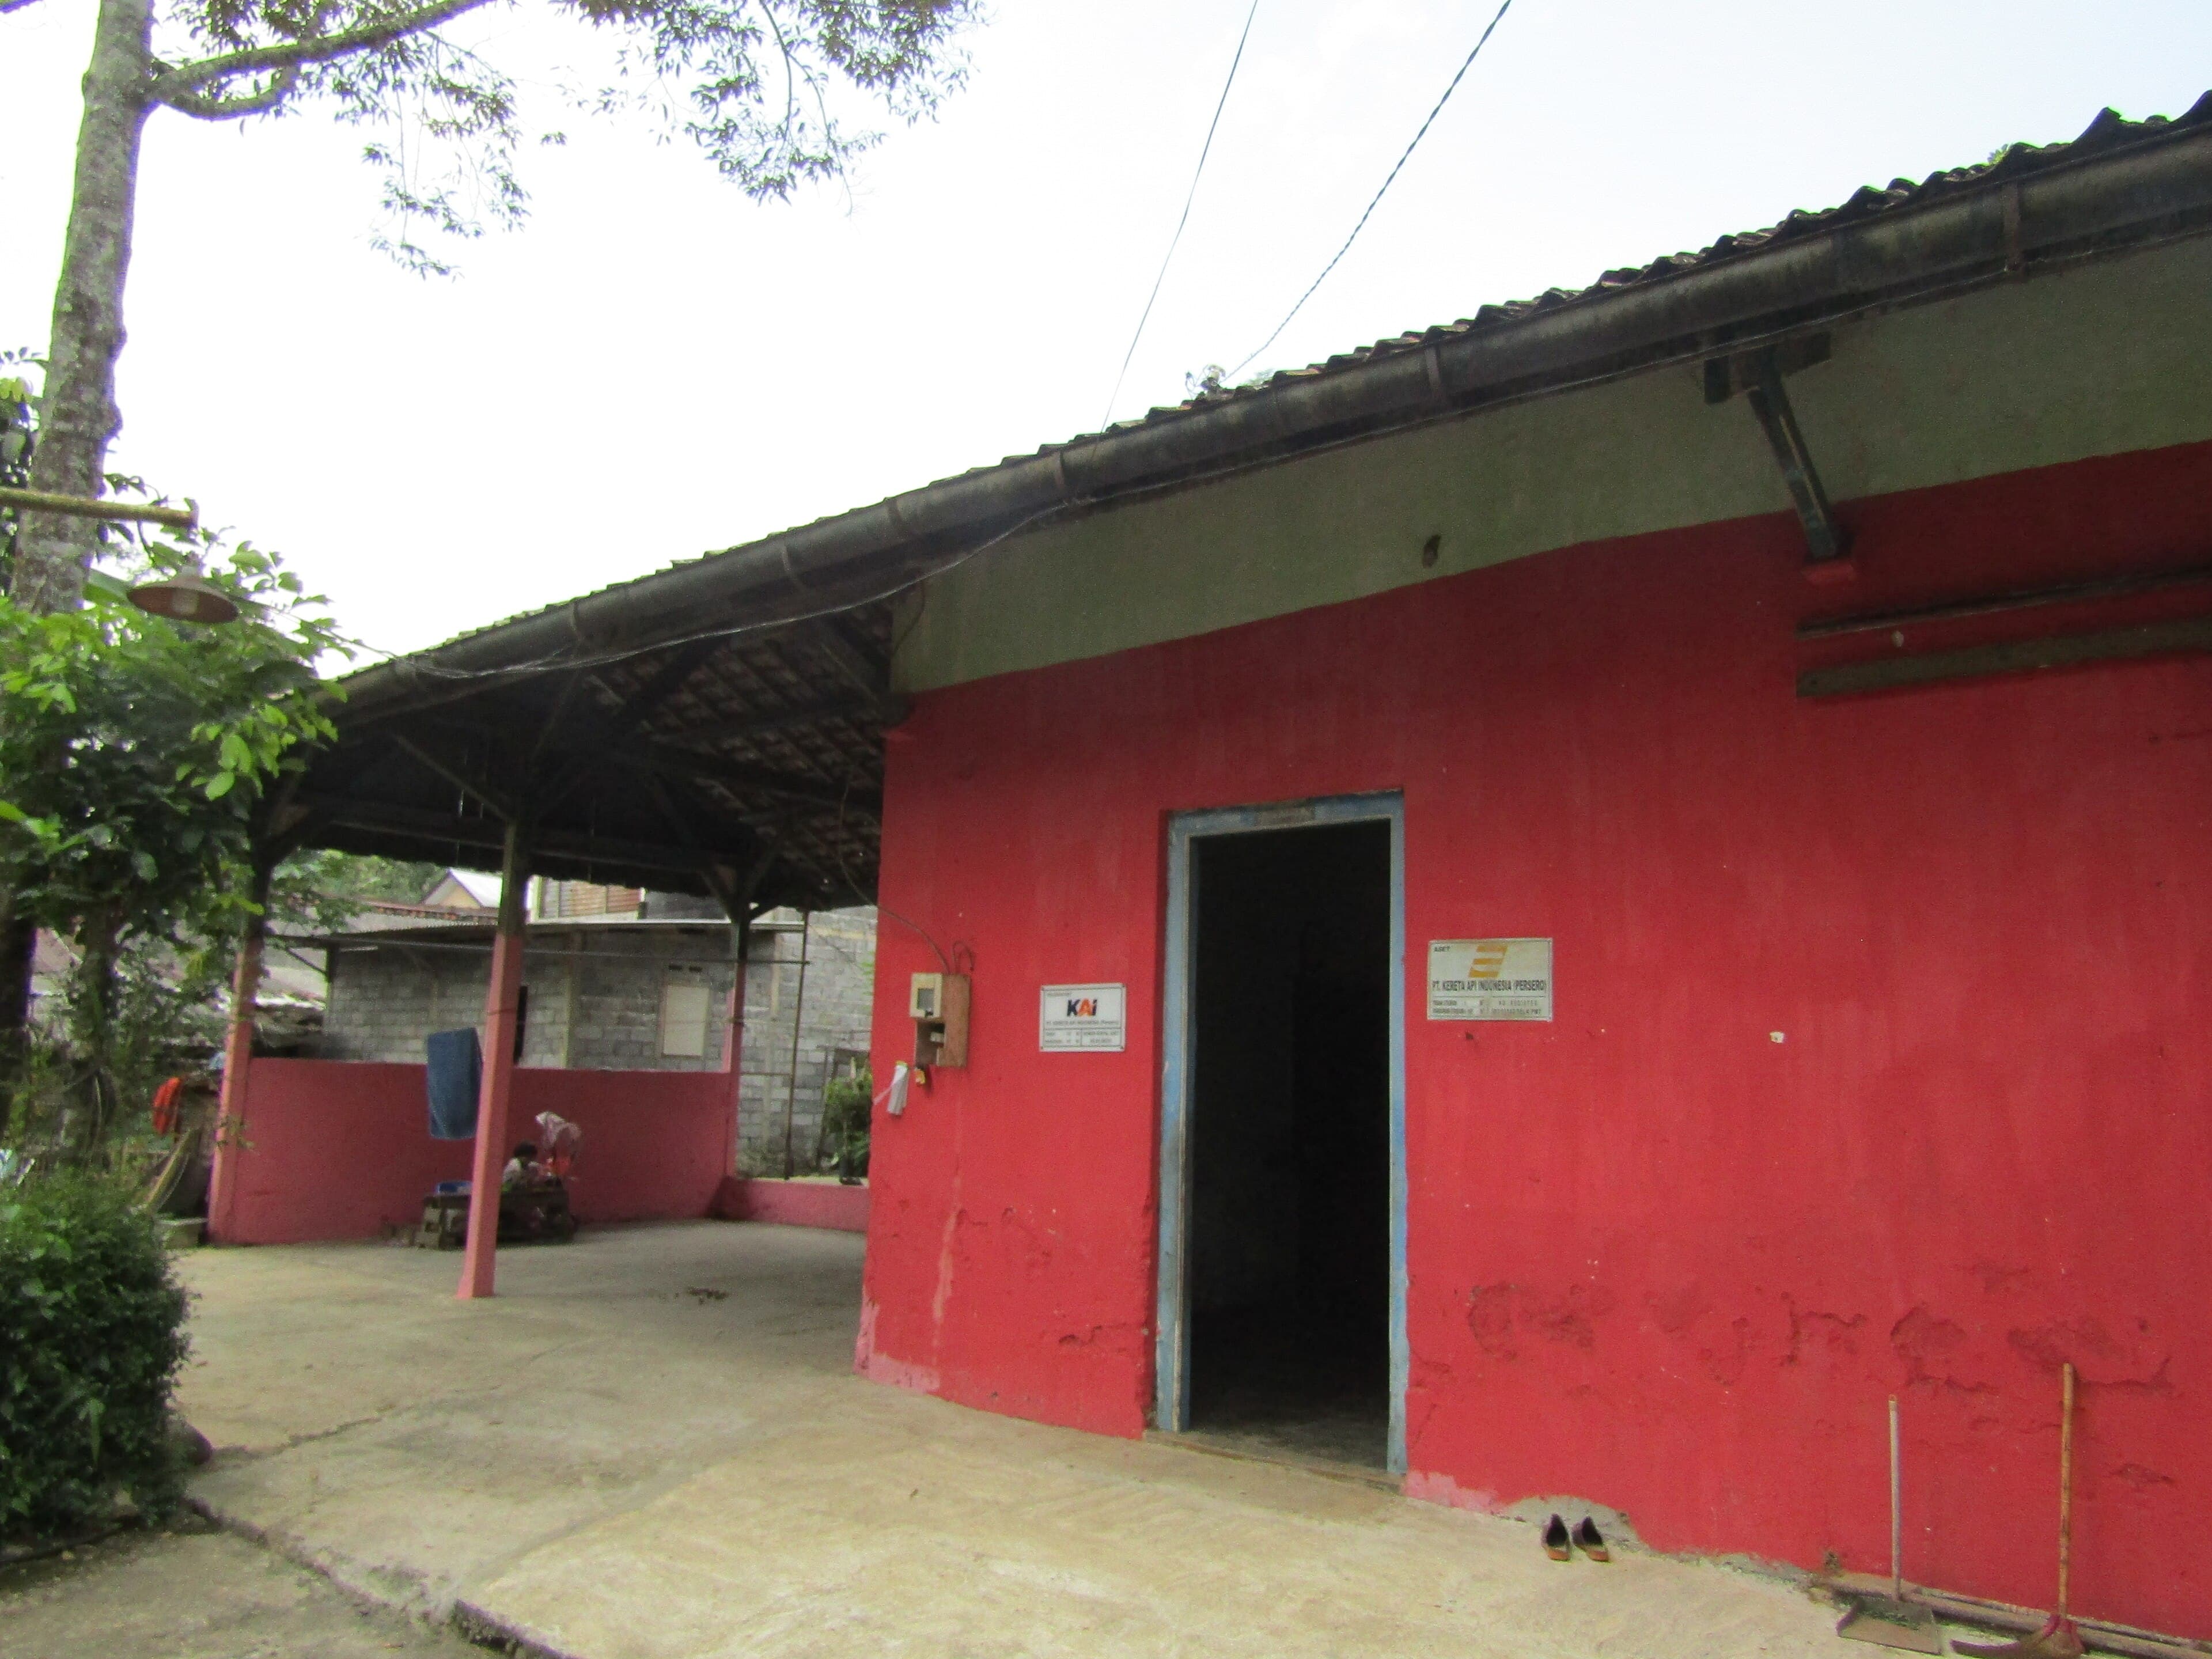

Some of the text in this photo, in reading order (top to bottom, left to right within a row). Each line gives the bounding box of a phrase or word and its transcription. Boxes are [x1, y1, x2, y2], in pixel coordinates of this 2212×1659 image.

[1442, 980, 1465, 991] KERETA
[1467, 980, 1477, 991] API
[1478, 980, 1512, 991] INDONESIA
